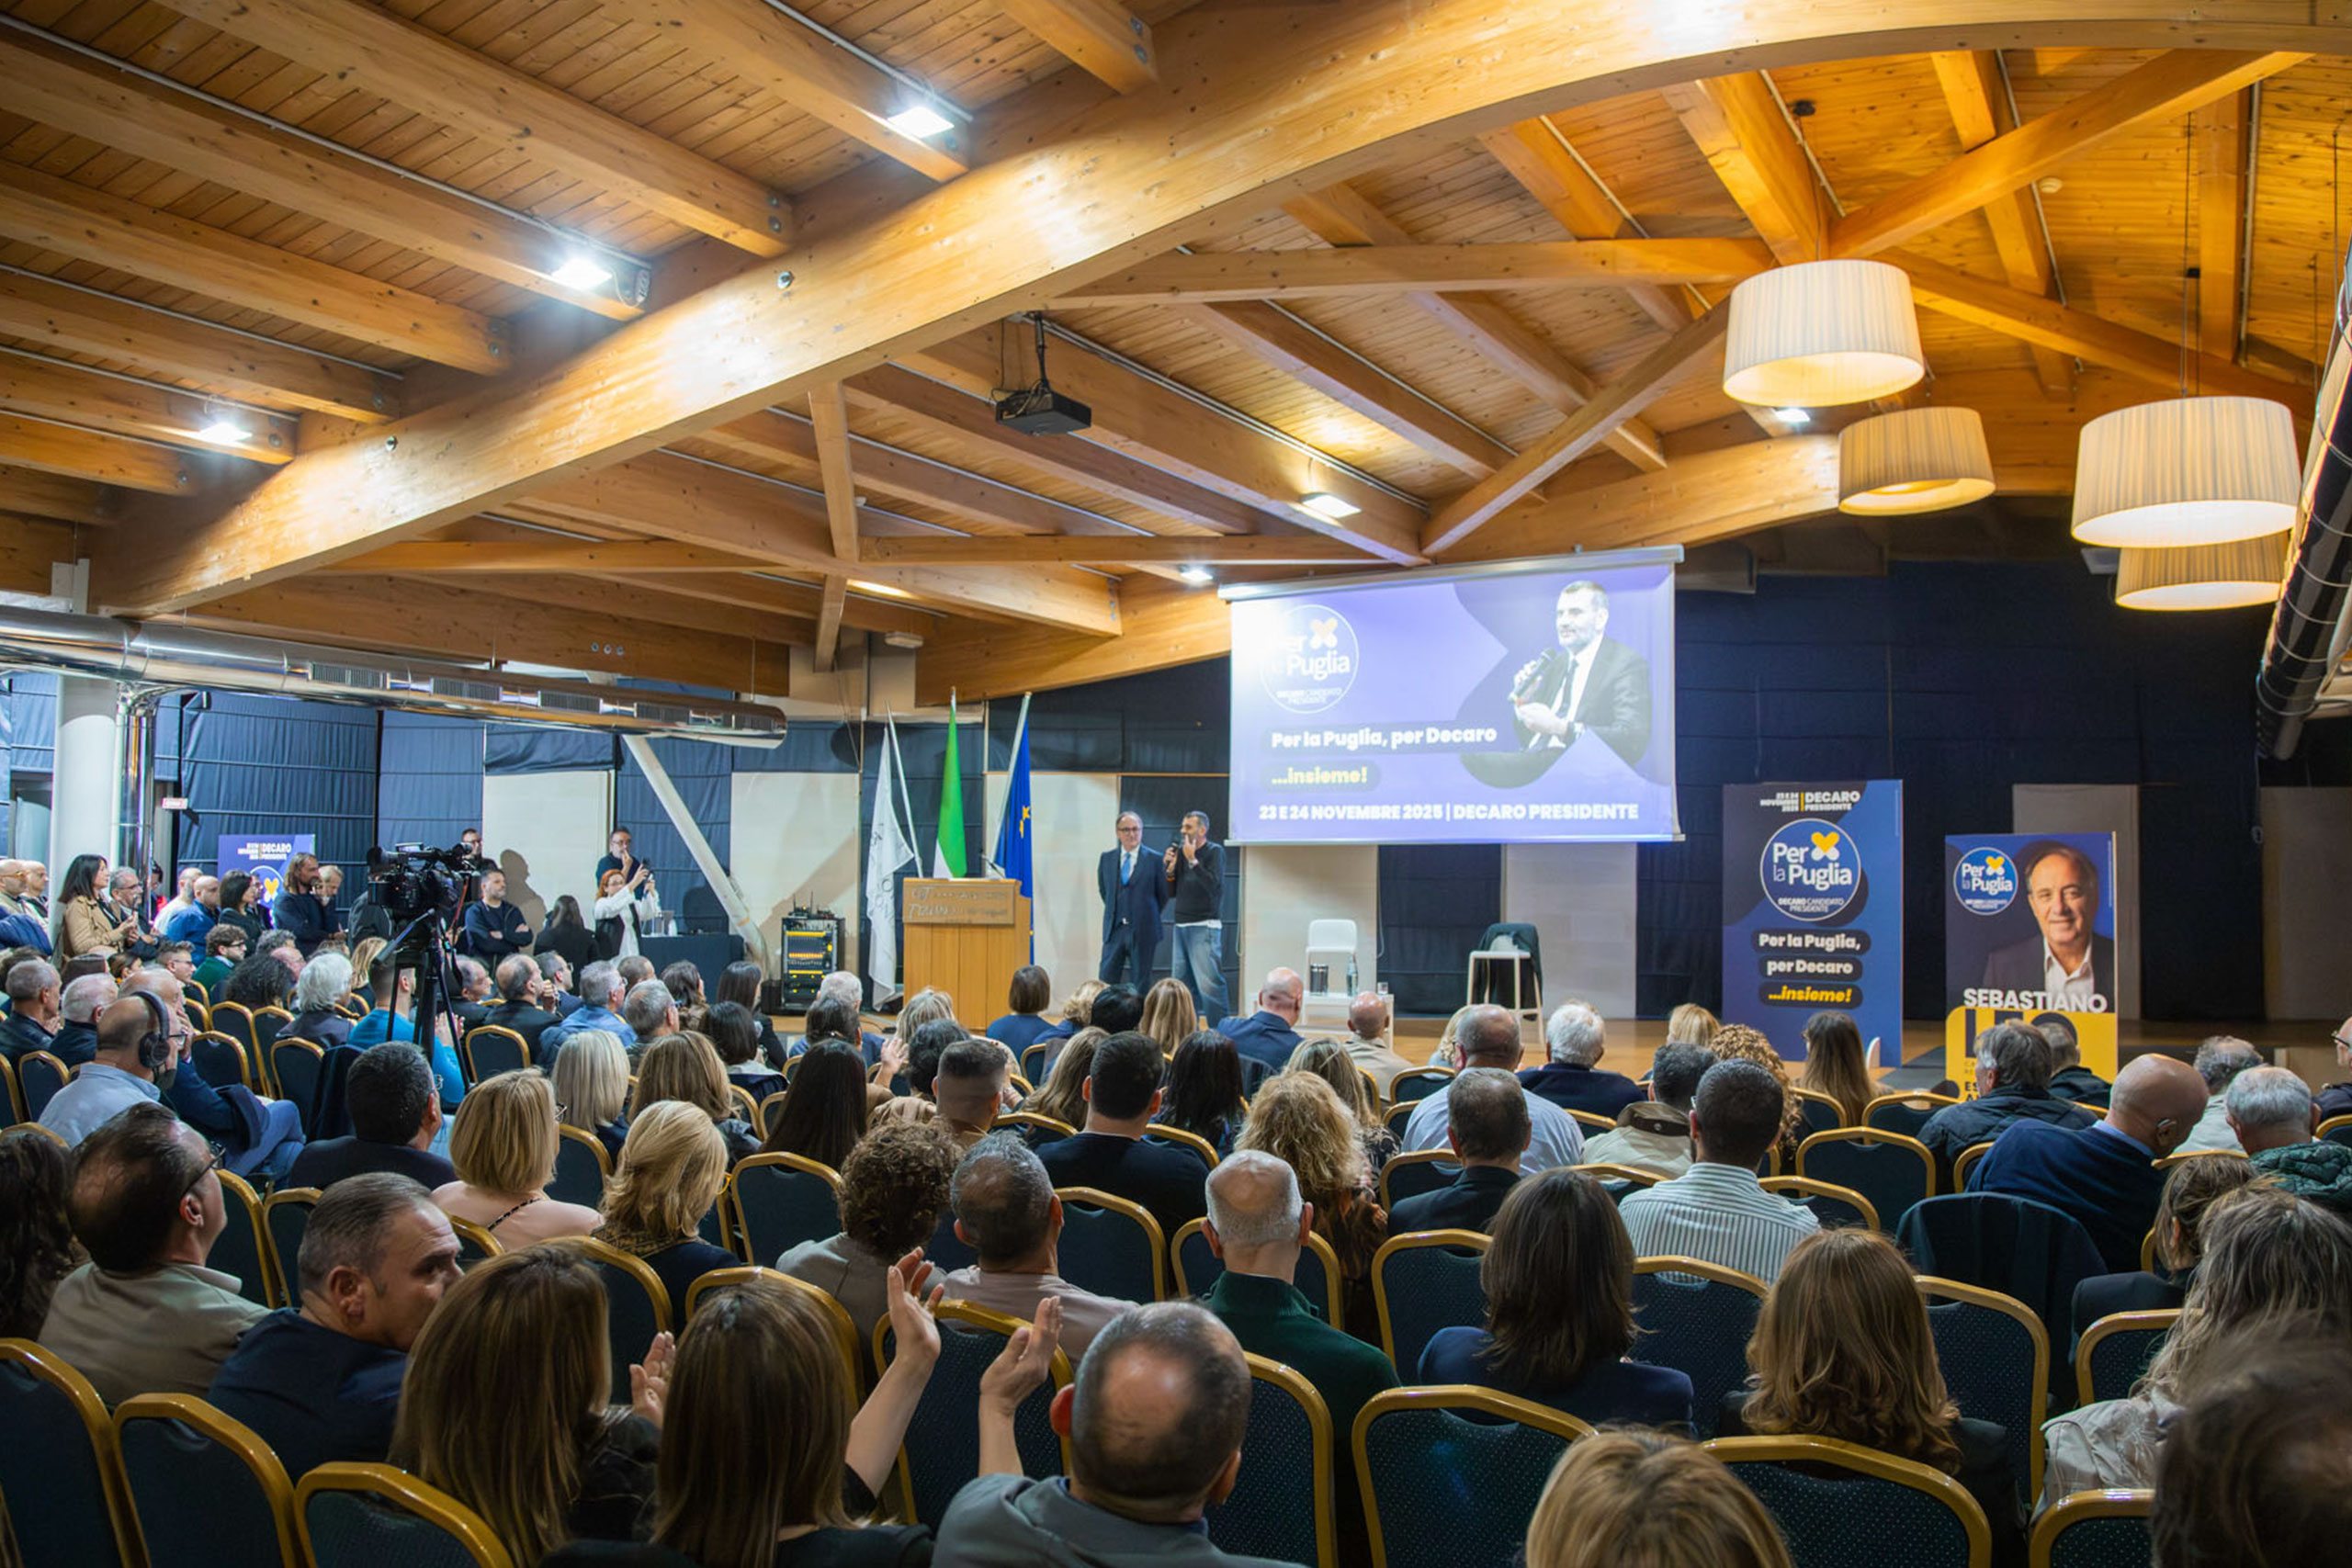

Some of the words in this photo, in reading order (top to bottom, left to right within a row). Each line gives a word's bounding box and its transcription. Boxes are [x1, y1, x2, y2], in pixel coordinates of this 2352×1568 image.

[1286, 649, 1351, 681] Puglia
[1272, 731, 1301, 748] Per
[1304, 730, 1320, 747] la
[1323, 728, 1388, 751] Puglia,
[1391, 730, 1423, 750] per
[1426, 727, 1498, 745] Decaro
[1804, 791, 1860, 803] DECARO
[1259, 805, 1277, 820] 23
[1279, 805, 1288, 820] E
[1290, 805, 1308, 820] 24
[1311, 804, 1401, 820] NOVEMBRE
[1402, 804, 1443, 819] 2025
[1453, 804, 1527, 819] DECARO
[1529, 803, 1639, 819] PRESIDENTE
[1773, 842, 1809, 863] Per
[1773, 863, 1786, 882] la
[1789, 863, 1852, 891] Puglia
[1962, 863, 1984, 877] Per
[1972, 876, 2013, 896] Puglia
[1758, 933, 1785, 947] Per
[1787, 933, 1803, 947] la
[1804, 933, 1860, 952] Puglia,
[1767, 960, 1794, 976] per
[1795, 959, 1853, 974] Decaro
[1768, 985, 1852, 1002] ...insieme!
[1963, 987, 2108, 1013] SEBASTIANO
